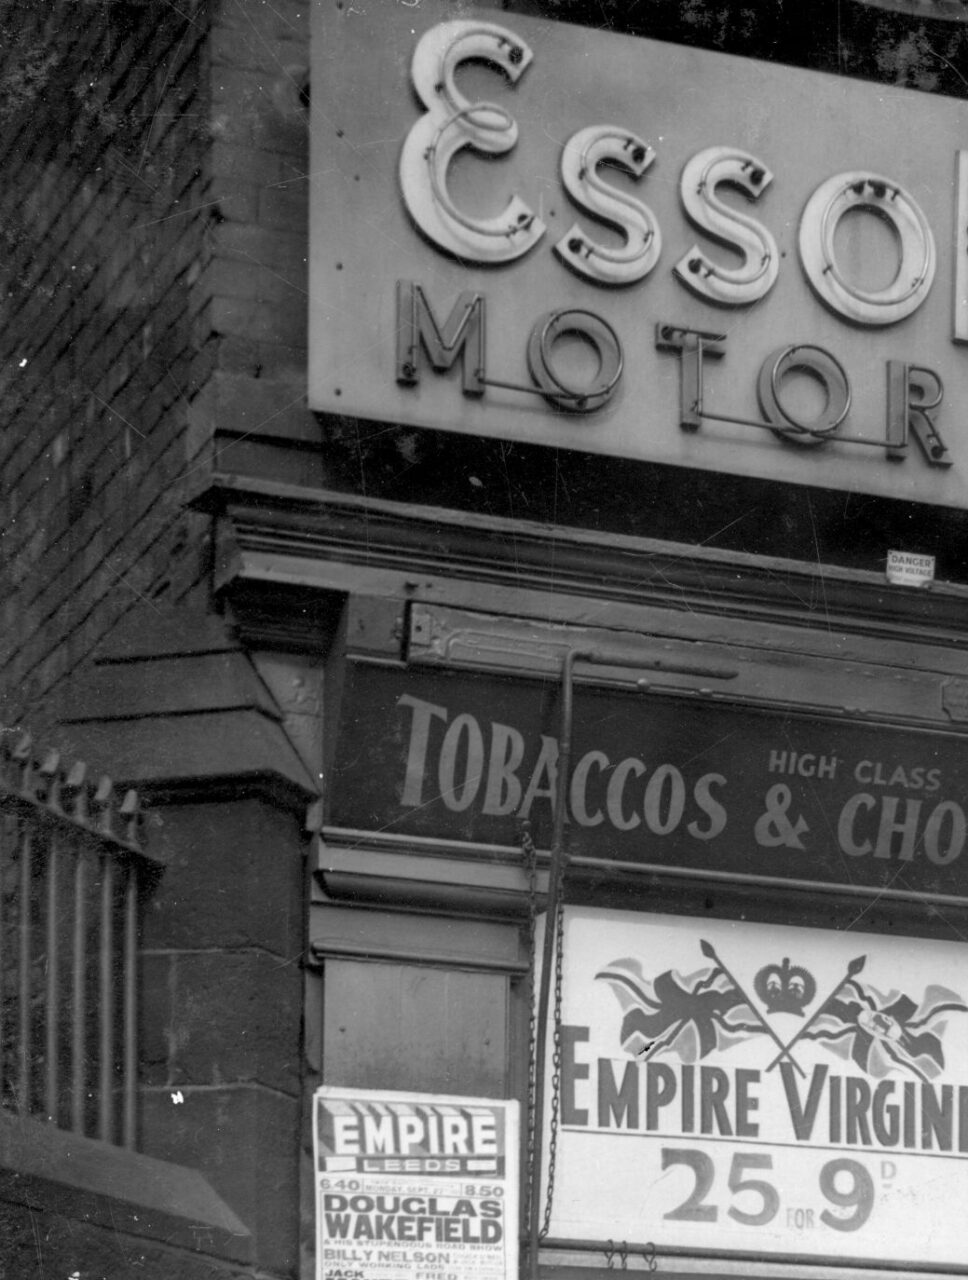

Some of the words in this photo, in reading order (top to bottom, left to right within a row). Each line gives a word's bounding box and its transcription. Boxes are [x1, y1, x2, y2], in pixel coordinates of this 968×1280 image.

[395, 279, 953, 467] MOTOR
[891, 555, 931, 567] DANGER
[397, 693, 728, 841] TOBACCOS
[754, 784, 809, 850] &
[768, 750, 837, 780] HIGH
[854, 760, 942, 792] CLASS
[559, 1024, 762, 1138] EMPIRE
[331, 1112, 498, 1156] EMPIRE
[362, 1158, 462, 1173] LEEDS
[323, 1193, 503, 1219] DOUGLAS
[661, 1147, 781, 1227] 25
[785, 1207, 815, 1230] FOR
[324, 1212, 504, 1245] WAKEFIELD
[323, 1248, 374, 1261] BILLY
[377, 1250, 451, 1265] NELSON
[325, 1269, 365, 1279] JACK
